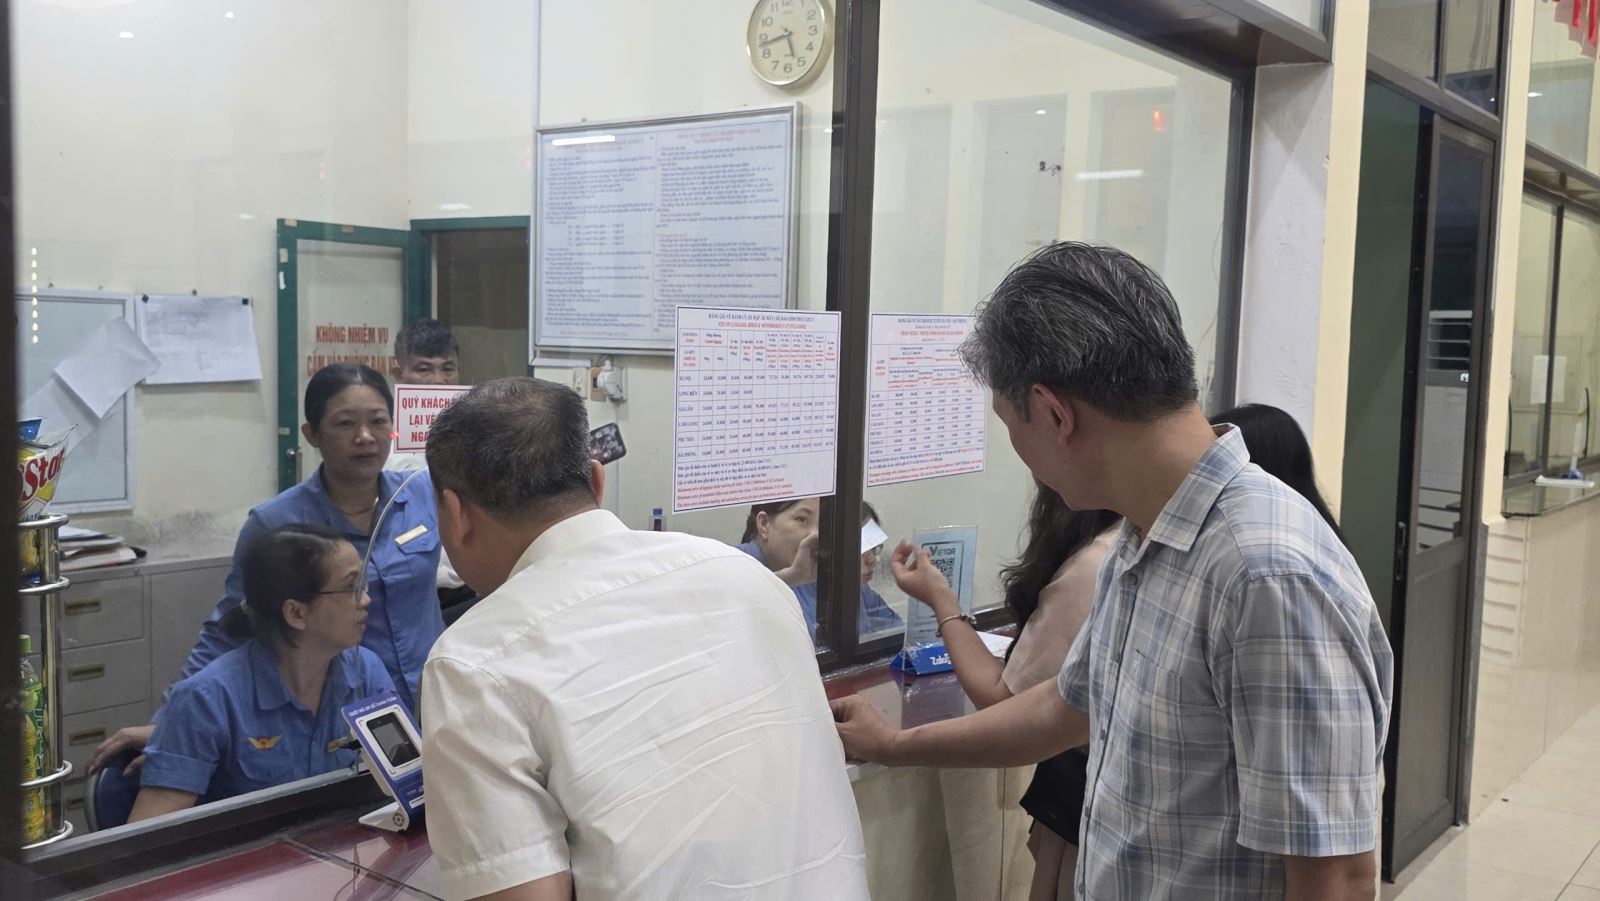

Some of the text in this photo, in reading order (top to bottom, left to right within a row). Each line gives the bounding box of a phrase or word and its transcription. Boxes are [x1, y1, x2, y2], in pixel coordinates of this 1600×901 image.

[770, 2, 779, 13] 11
[807, 9, 817, 21] 2
[761, 16, 773, 28] 10
[808, 25, 818, 36] 3
[759, 33, 768, 44] 9
[805, 41, 814, 52] 4
[762, 48, 771, 59] 8
[771, 60, 779, 71] 7
[797, 56, 806, 67] 5
[783, 63, 792, 73] 6
[316, 322, 346, 344] KHÔNG
[347, 323, 376, 347] NHIỆM
[402, 395, 419, 410] QUÝ
[421, 396, 450, 409] KHÁCH
[409, 414, 424, 428] LẠI
